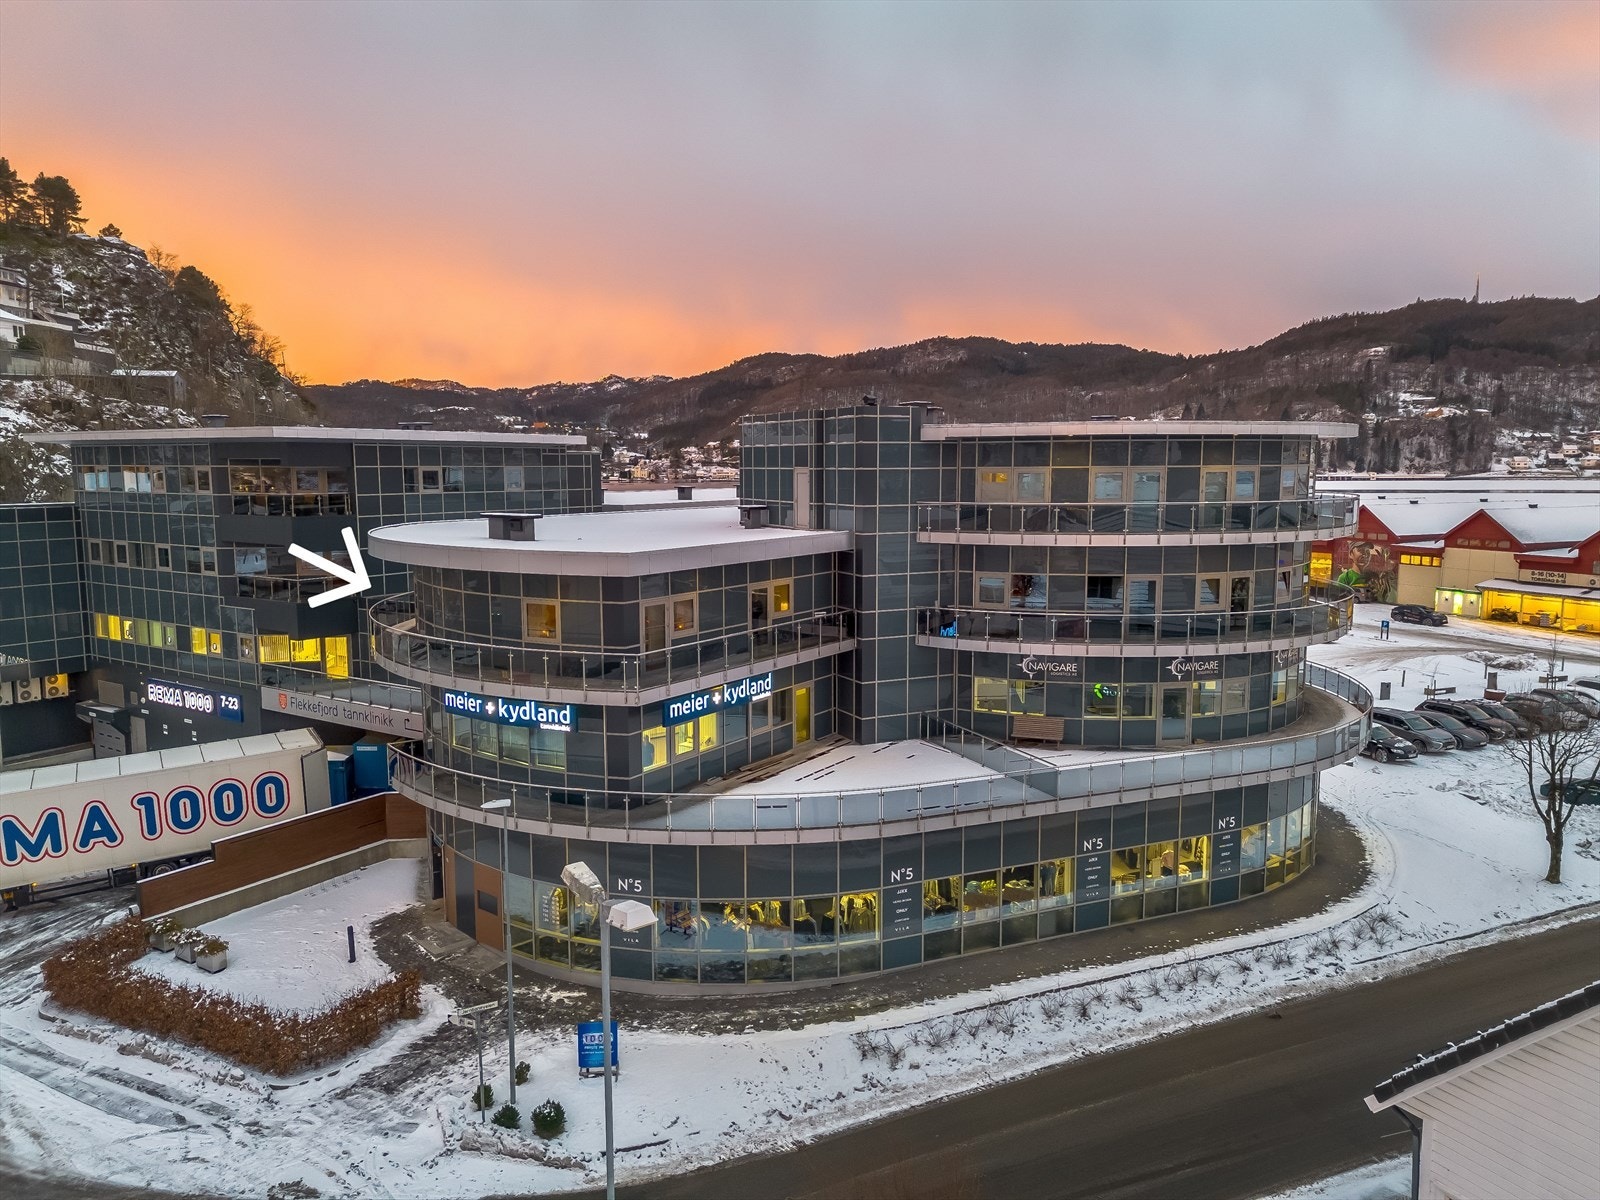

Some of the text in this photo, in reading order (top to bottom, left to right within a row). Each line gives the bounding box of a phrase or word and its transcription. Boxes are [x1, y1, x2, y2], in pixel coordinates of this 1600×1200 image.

[1028, 662, 1078, 672] NAVIGARE
[1177, 661, 1219, 671] NAVIGARE
[147, 684, 214, 713] REMA 1000
[220, 695, 239, 710] 7-23
[444, 691, 482, 713] meier
[498, 699, 571, 724] kydland
[669, 693, 709, 718] meier
[723, 672, 772, 704] kydland
[290, 696, 394, 728] Flekkefjord tannklinikk
[131, 770, 291, 841] 1000
